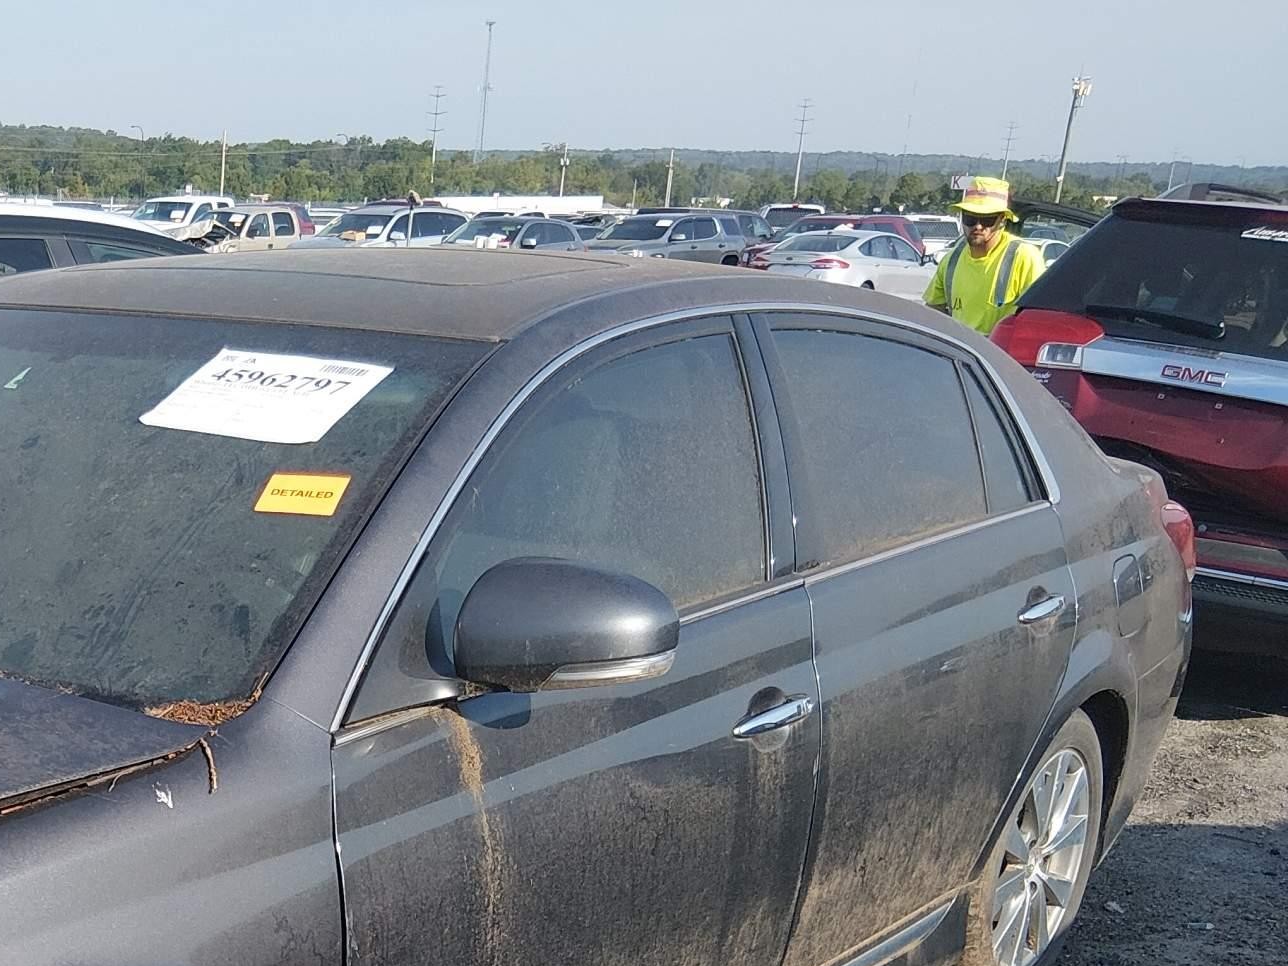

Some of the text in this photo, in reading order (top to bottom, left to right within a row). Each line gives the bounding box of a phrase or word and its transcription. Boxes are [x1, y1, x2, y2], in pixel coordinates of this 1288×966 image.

[952, 175, 962, 189] K
[211, 367, 352, 396] 45962797
[1161, 365, 1229, 388] GMC
[270, 488, 334, 499] DETAILED
